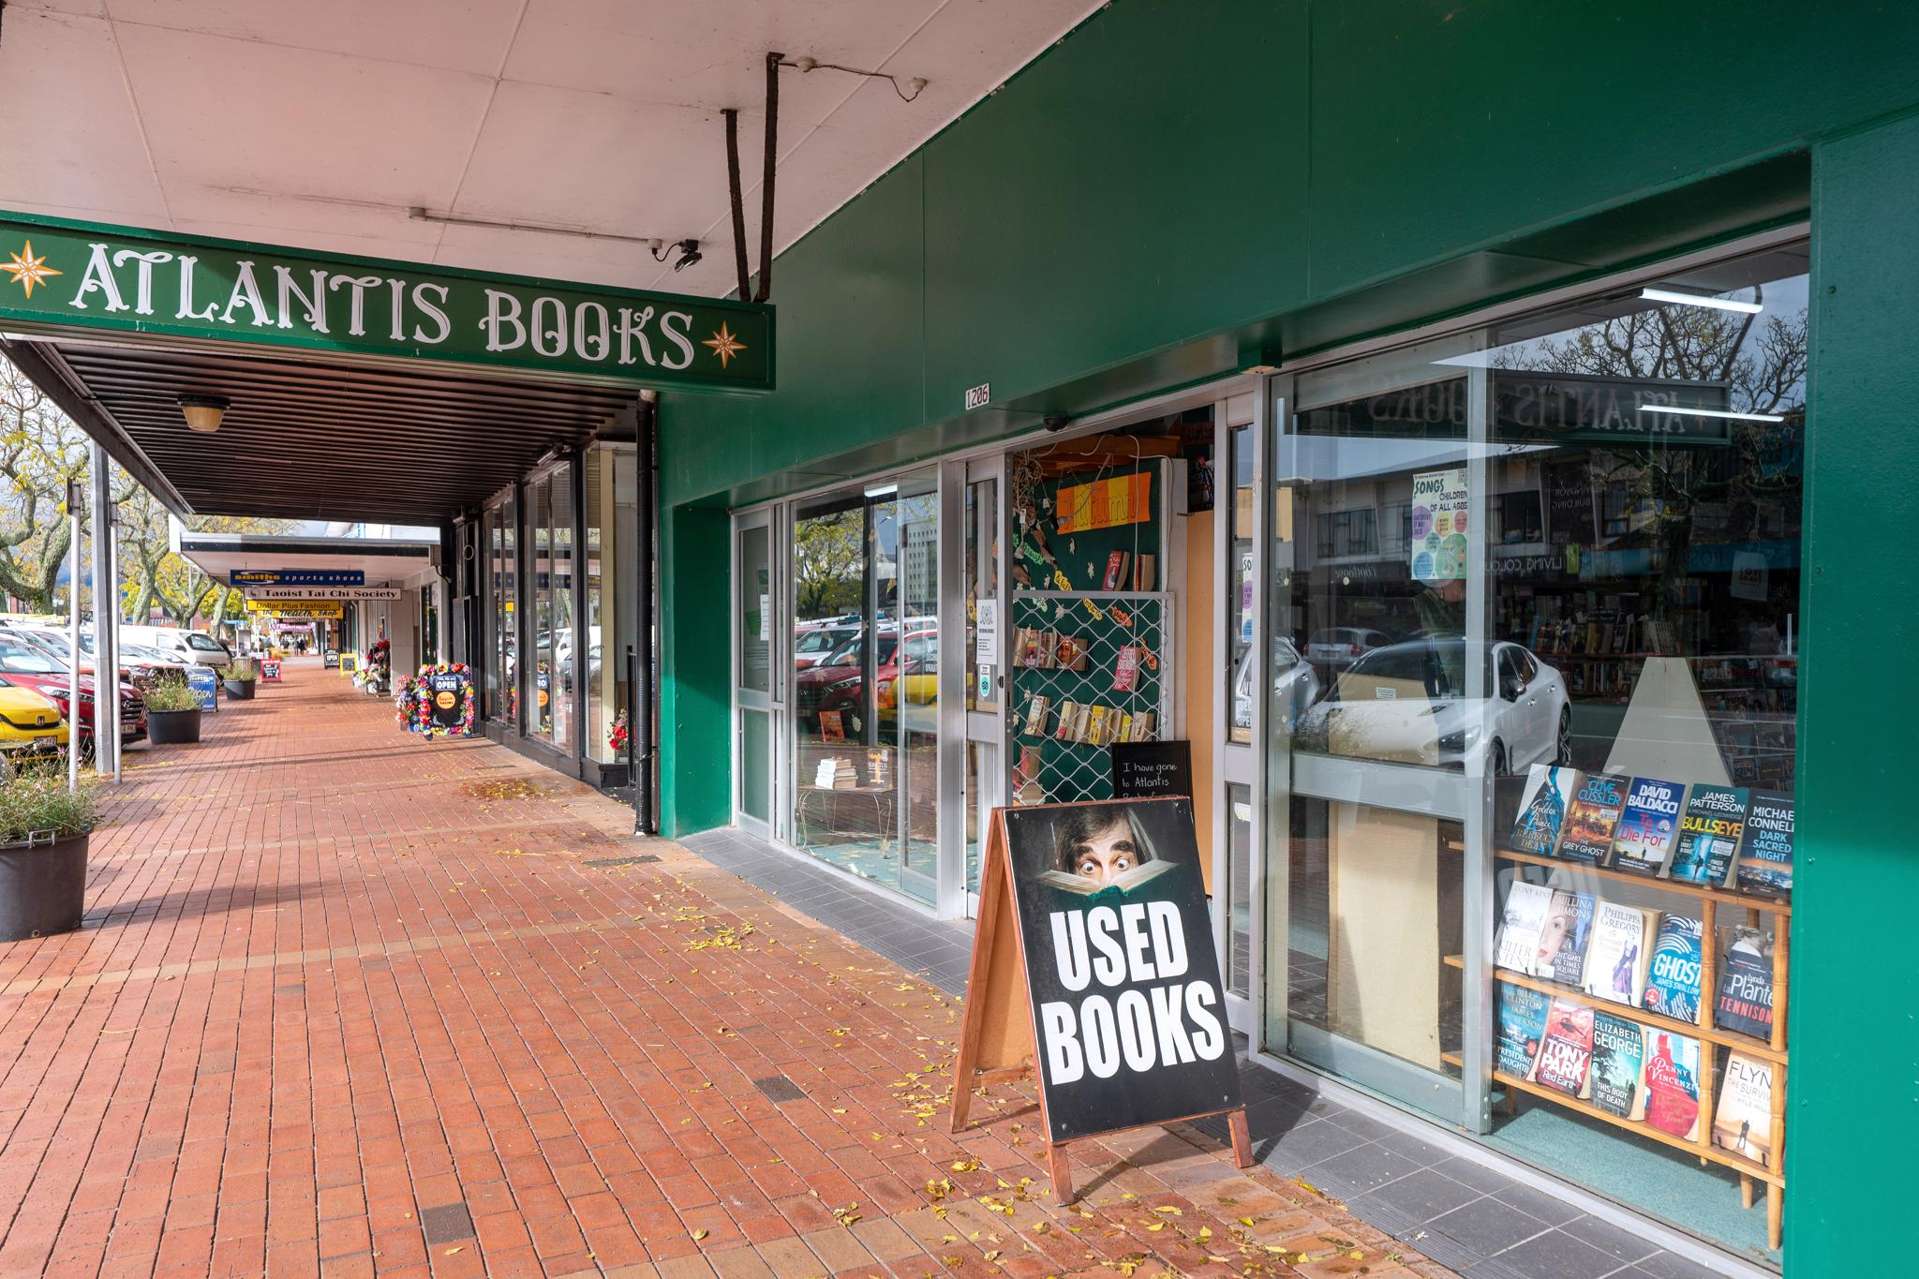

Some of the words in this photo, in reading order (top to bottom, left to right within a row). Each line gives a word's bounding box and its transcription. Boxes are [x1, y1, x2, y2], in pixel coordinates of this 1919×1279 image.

[69, 242, 450, 345] ATLANTIS
[479, 288, 696, 370] BOOKS
[967, 384, 988, 408] 1206
[1414, 479, 1444, 497] SONGS
[1439, 503, 1451, 511] ALL
[264, 589, 302, 598] Taoist
[308, 589, 325, 598] Tai
[330, 589, 350, 598] Chi
[354, 588, 397, 599] Society
[436, 681, 456, 690] OPEN
[1123, 762, 1130, 772] I
[1134, 763, 1154, 772] have
[1122, 778, 1129, 788] to
[1135, 774, 1170, 788] Atlantis
[1588, 780, 1616, 793] CLIVE
[1578, 789, 1621, 807] CUSSLER
[1639, 784, 1672, 801] DAVID
[1702, 791, 1736, 804] JAMES
[1627, 794, 1679, 815] BALDACCI
[1689, 798, 1746, 814] PATTERSON
[1681, 816, 1743, 837] BULLSEYE
[1760, 830, 1788, 843] DARK
[1562, 841, 1579, 852] GREY
[1580, 845, 1605, 858] GHOST
[1753, 839, 1792, 853] SACRED
[1755, 849, 1787, 862] NIGHT
[1049, 901, 1189, 992] USED
[1720, 995, 1773, 1025] TENNISON
[1040, 980, 1225, 1086] BOOKS
[1595, 1020, 1641, 1042] ELIZABETH
[1547, 1037, 1589, 1061] TONY
[1594, 1031, 1641, 1058] GEORGE
[1541, 1052, 1585, 1083] PARK
[1597, 1090, 1605, 1099] OF
[1606, 1093, 1626, 1108] DEATH
[1598, 1081, 1611, 1093] THIS
[1612, 1085, 1628, 1099] BODY
